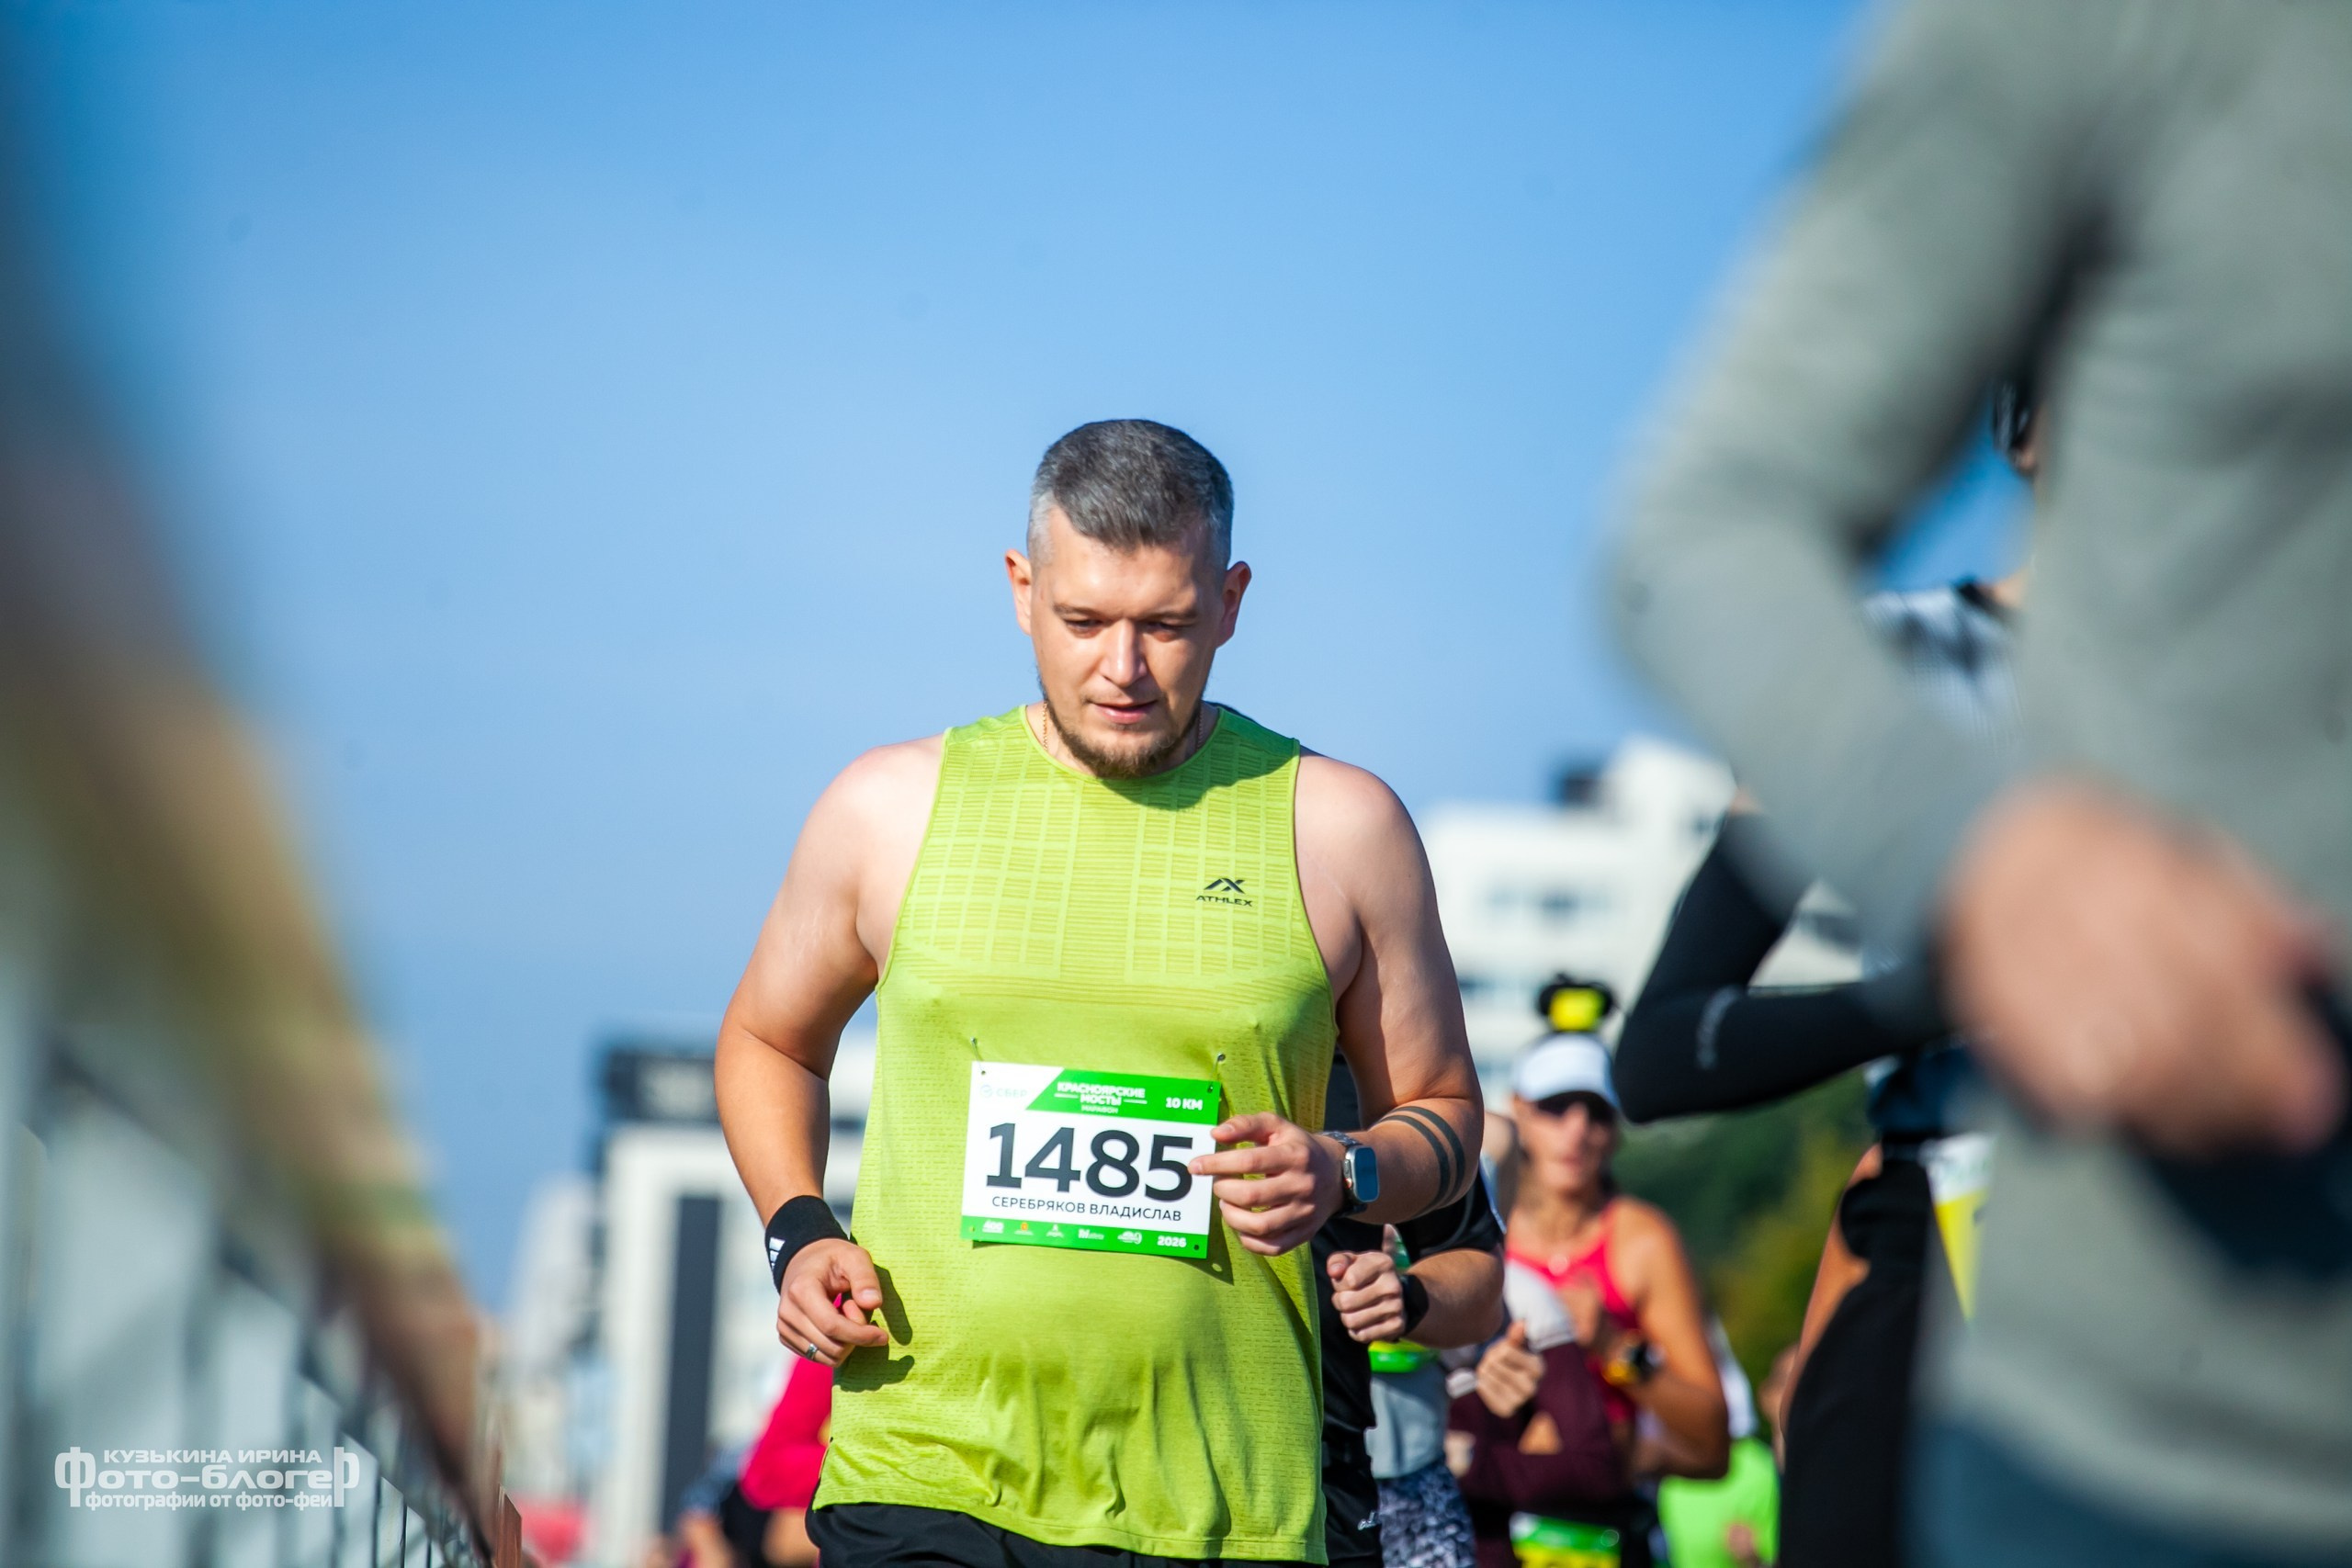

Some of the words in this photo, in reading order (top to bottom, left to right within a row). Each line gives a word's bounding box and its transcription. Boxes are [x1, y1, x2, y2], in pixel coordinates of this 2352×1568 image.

[1196, 895, 1252, 908] ATHLEX
[1057, 1082, 1146, 1099] КРАСНОЯРСКИЕ
[1080, 1094, 1122, 1106] МОСТЫ
[1166, 1097, 1182, 1109] 10
[1182, 1099, 1204, 1111] КМ
[986, 1122, 1193, 1202] 1485
[992, 1196, 1086, 1213] СЕРЕБРЯКОВ
[1090, 1204, 1182, 1222] ВЛАДИСЛАВ
[1157, 1235, 1187, 1247] 2026
